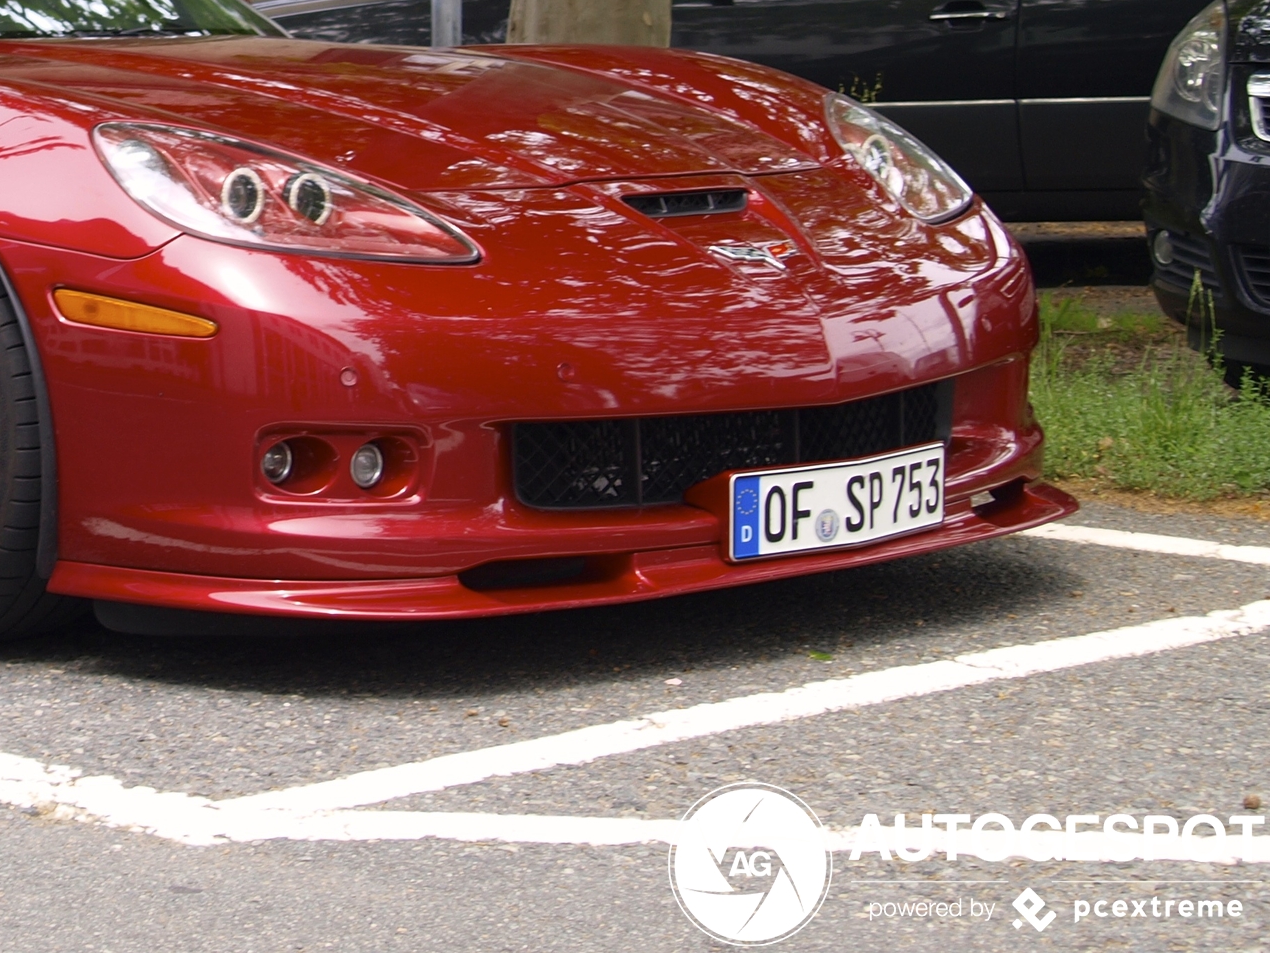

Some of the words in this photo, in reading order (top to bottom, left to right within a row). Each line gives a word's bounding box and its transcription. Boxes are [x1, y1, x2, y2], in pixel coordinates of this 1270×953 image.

[764, 481, 814, 543] OF
[845, 471, 883, 532] SP
[892, 458, 940, 524] 753
[741, 525, 753, 543] D
